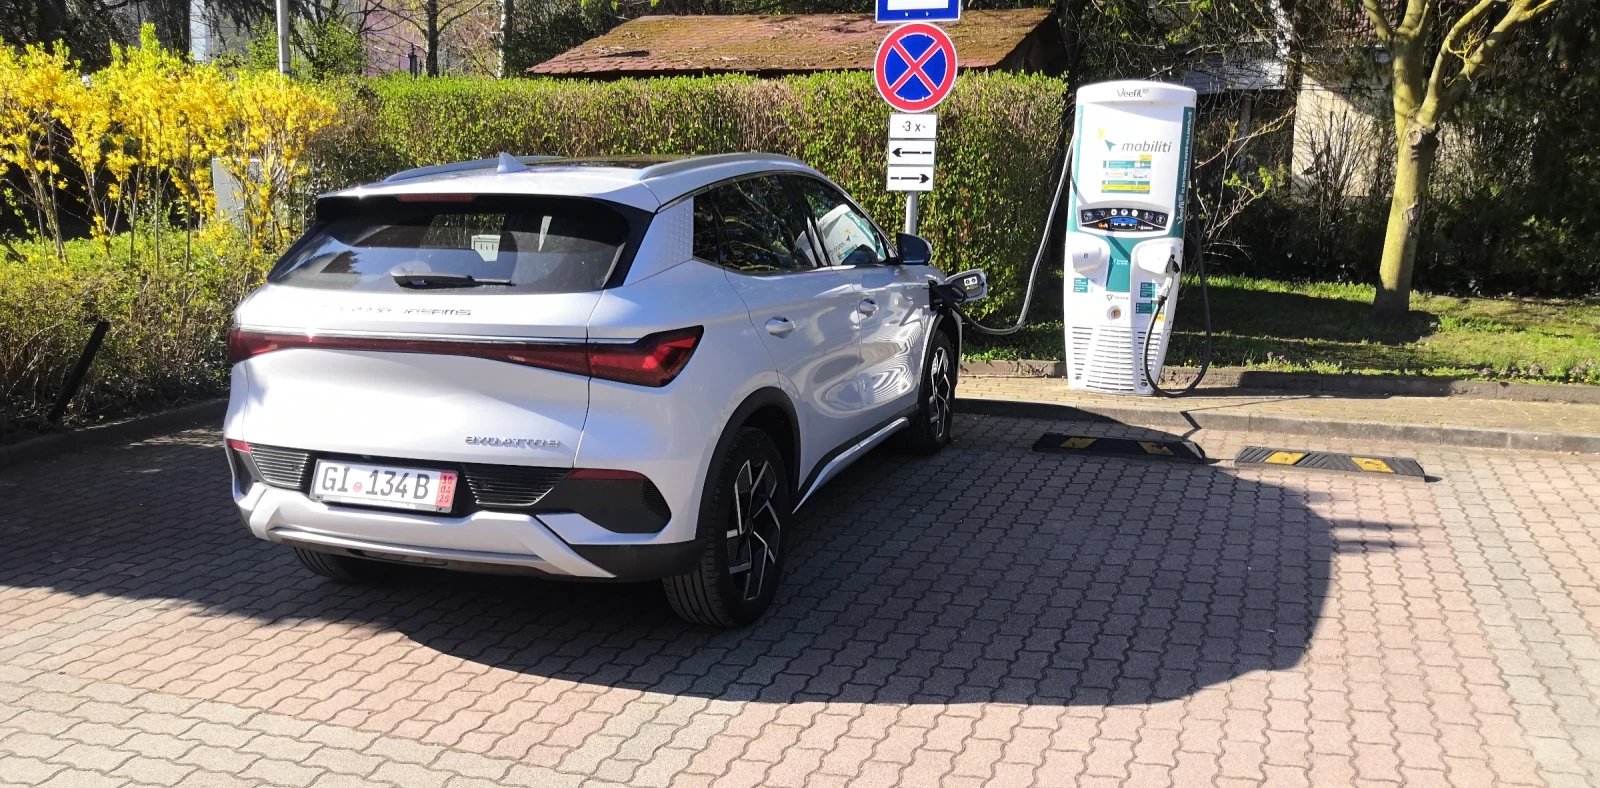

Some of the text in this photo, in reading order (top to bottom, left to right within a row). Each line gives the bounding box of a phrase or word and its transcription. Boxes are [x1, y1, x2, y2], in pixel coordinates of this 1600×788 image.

[904, 120, 921, 132] 3 x
[1121, 140, 1172, 153] mobiliti
[322, 466, 430, 500] GI 134 B
[441, 475, 452, 485] 30
